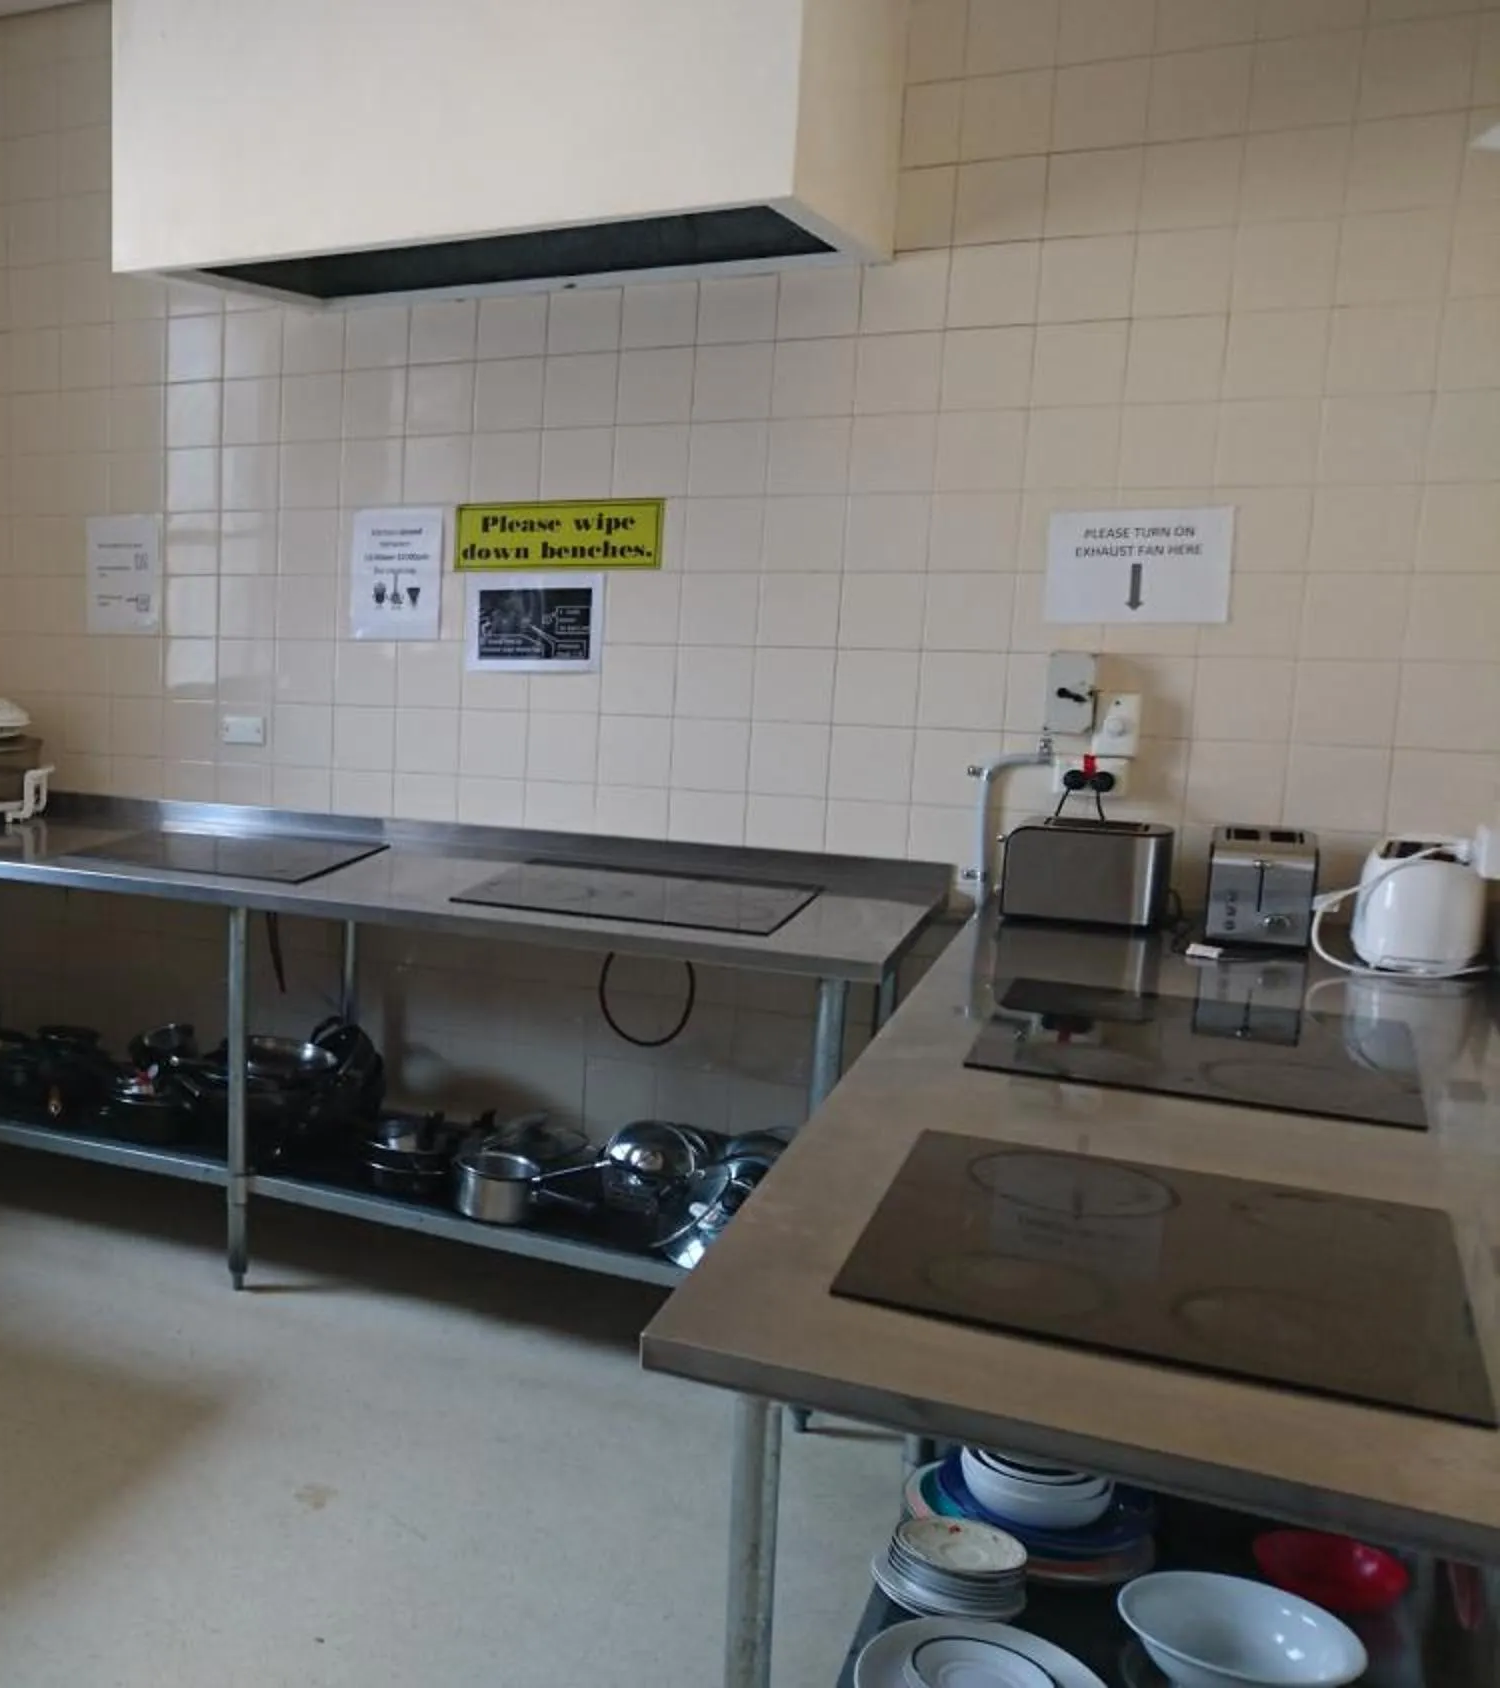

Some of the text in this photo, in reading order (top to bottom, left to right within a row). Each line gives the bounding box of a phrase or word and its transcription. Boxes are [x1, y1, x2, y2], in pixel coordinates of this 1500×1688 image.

[481, 512, 636, 535] Please wipe
[1083, 525, 1196, 540] PLEASE TURN ON
[462, 540, 653, 561] down benches.
[1075, 543, 1203, 559] EXHAUST FAN HERE
